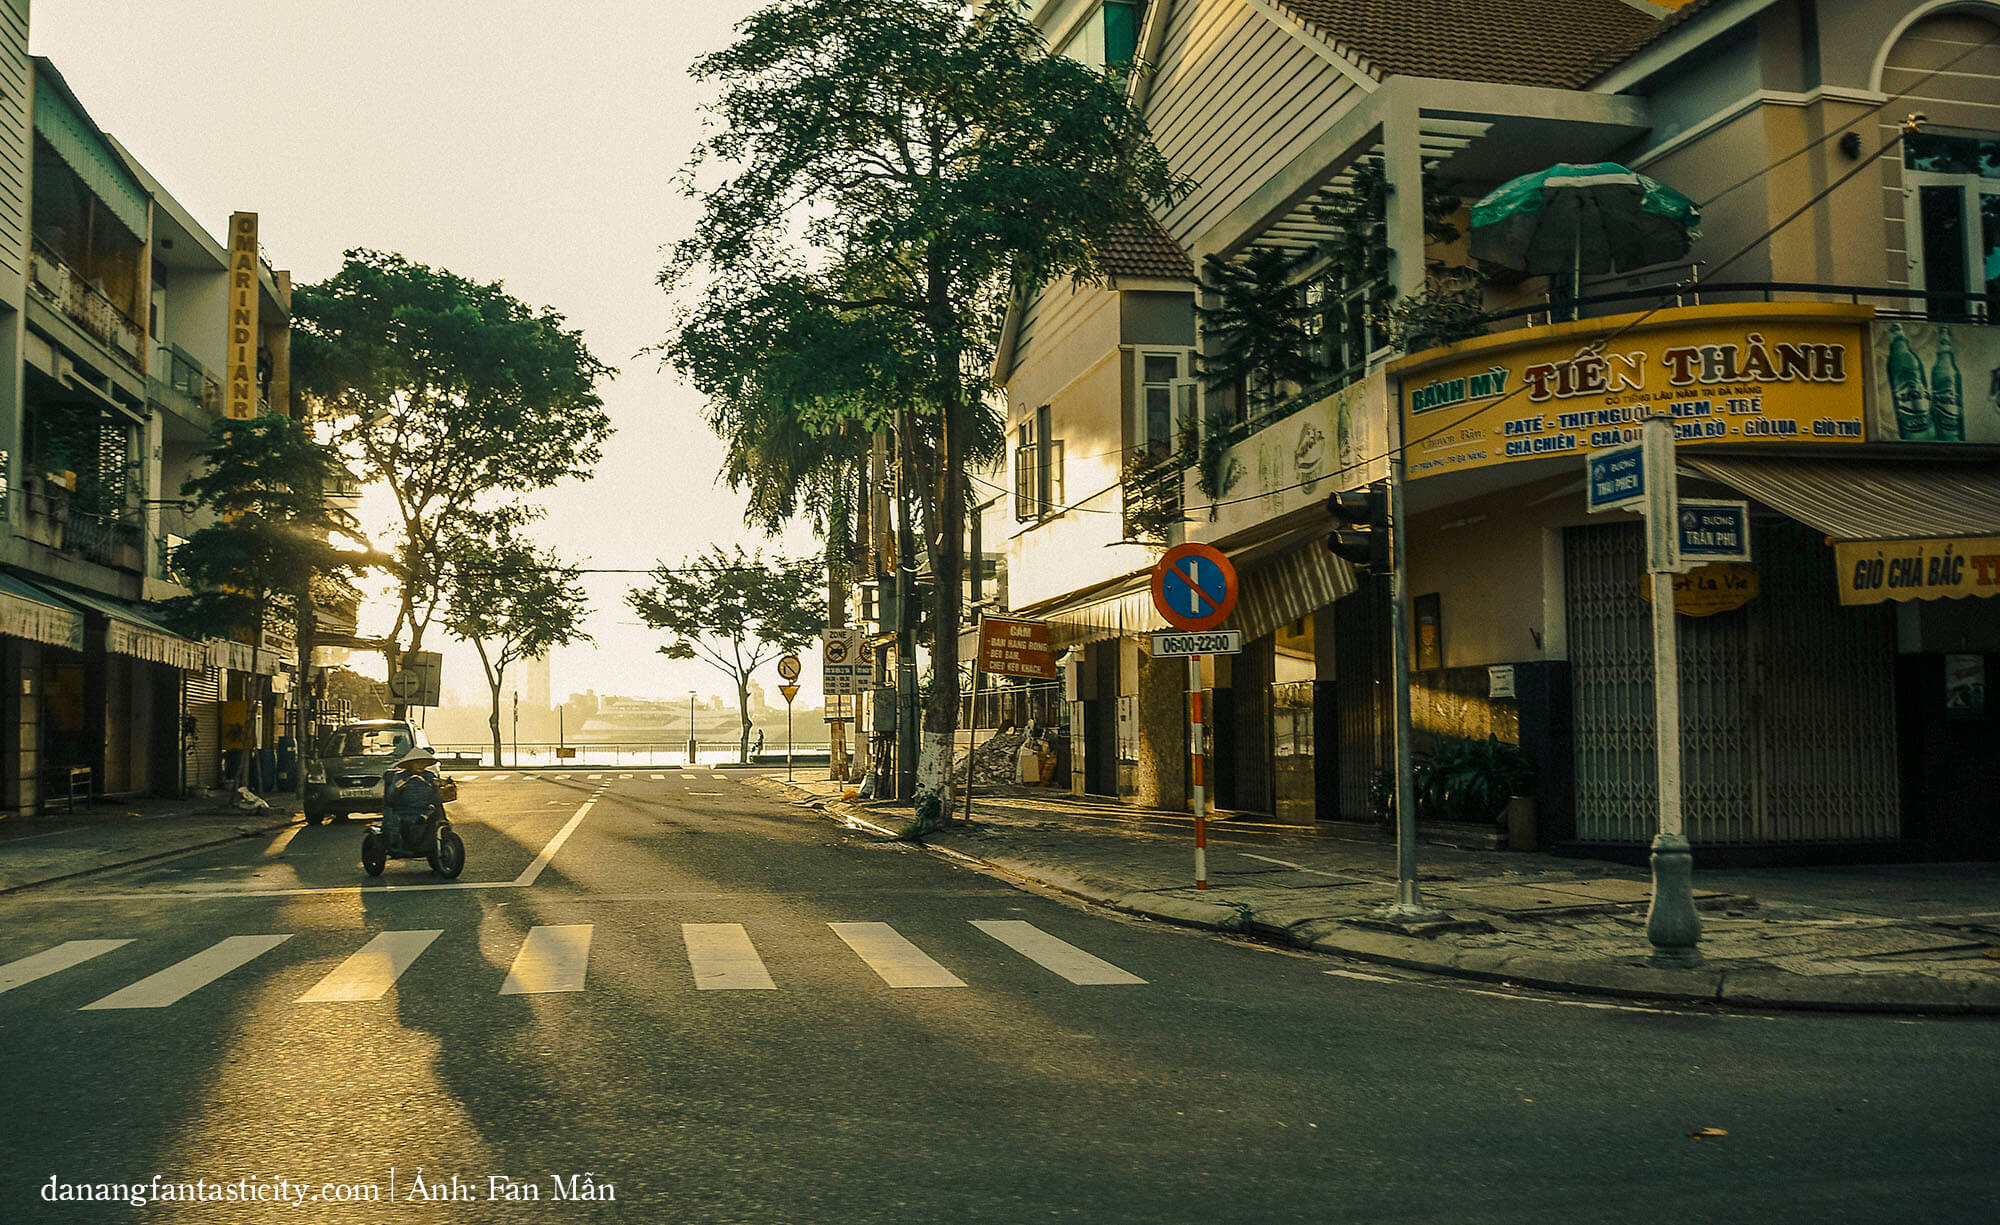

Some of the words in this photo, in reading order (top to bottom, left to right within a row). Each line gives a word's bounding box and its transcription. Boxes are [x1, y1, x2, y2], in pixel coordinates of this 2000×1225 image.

[1411, 377, 1465, 414] BÁNH
[1523, 339, 1648, 402] TIẾN
[1663, 332, 1847, 386] THÀNH
[1670, 400, 1712, 418] NEM
[1854, 551, 1885, 590] GIÒ
[829, 630, 847, 639] ZONE
[1163, 634, 1229, 654] 06:00-22:00
